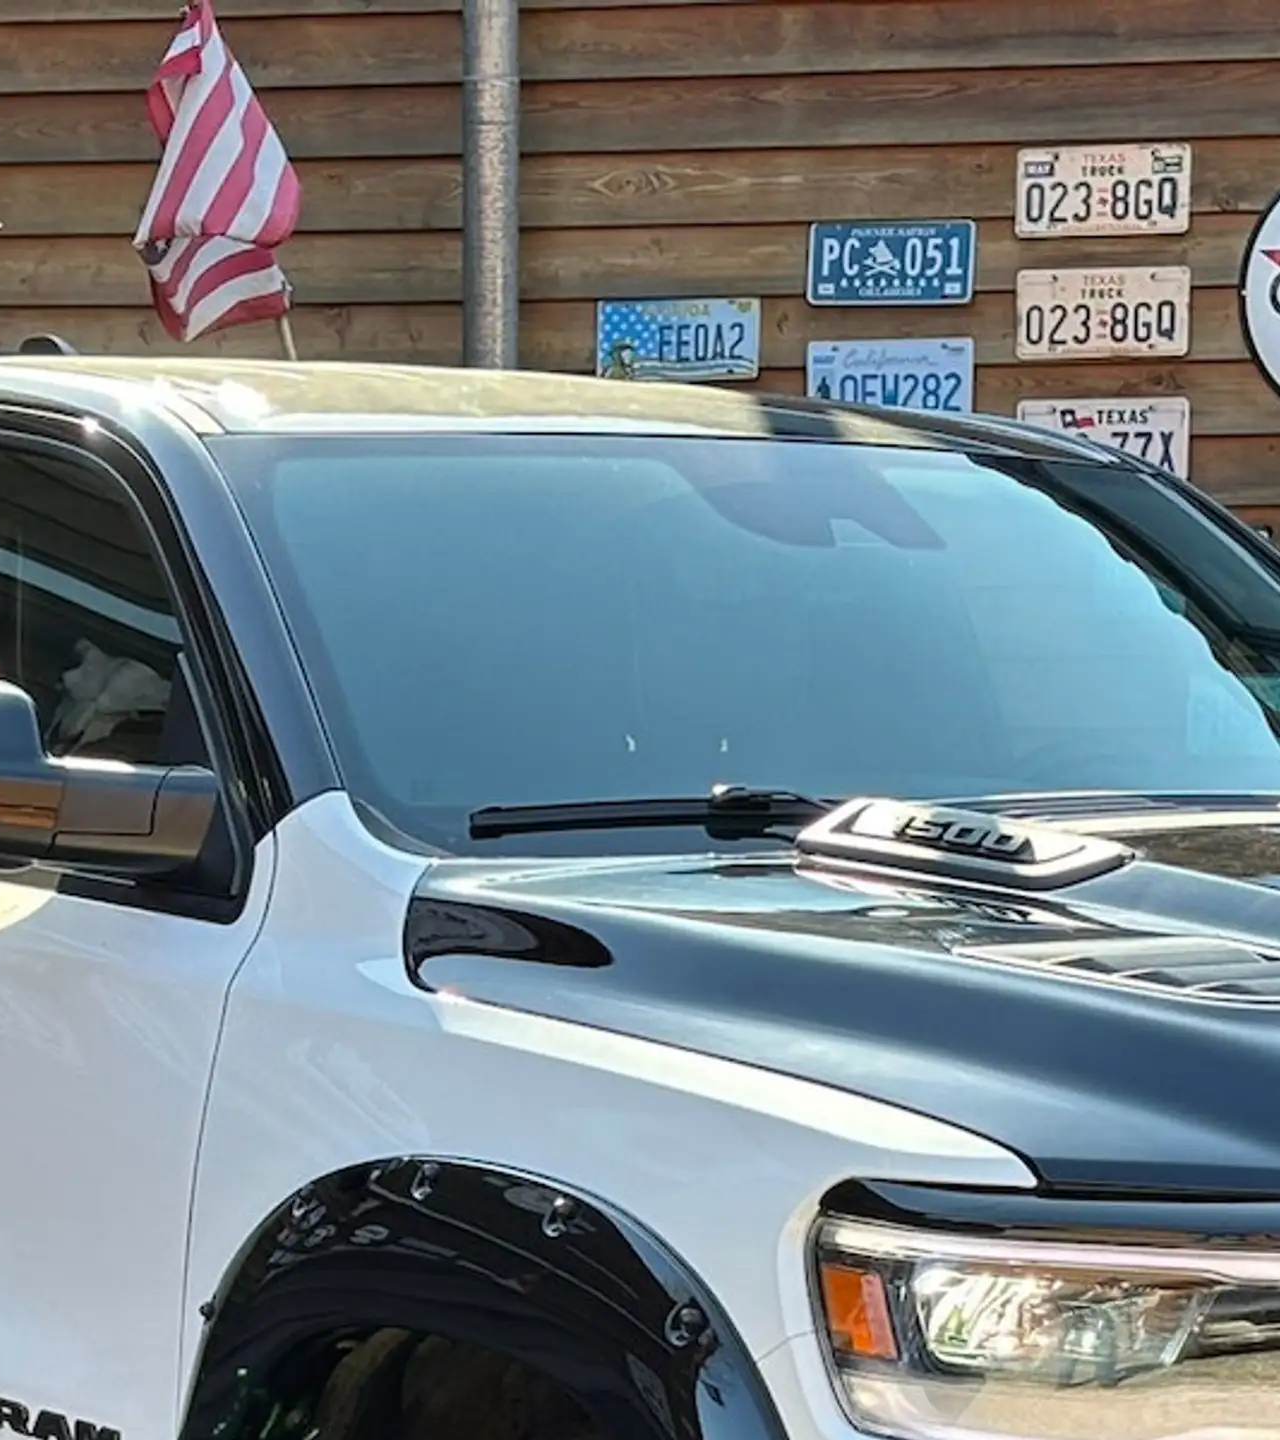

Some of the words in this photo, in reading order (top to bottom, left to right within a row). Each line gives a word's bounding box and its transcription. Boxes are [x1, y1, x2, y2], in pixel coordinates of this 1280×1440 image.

[1082, 153, 1126, 164] TEXAS
[1082, 165, 1125, 177] TRUCK
[1083, 275, 1126, 286] TEXAS
[1081, 287, 1125, 298] TRUCK
[1097, 409, 1149, 425] TEXAS
